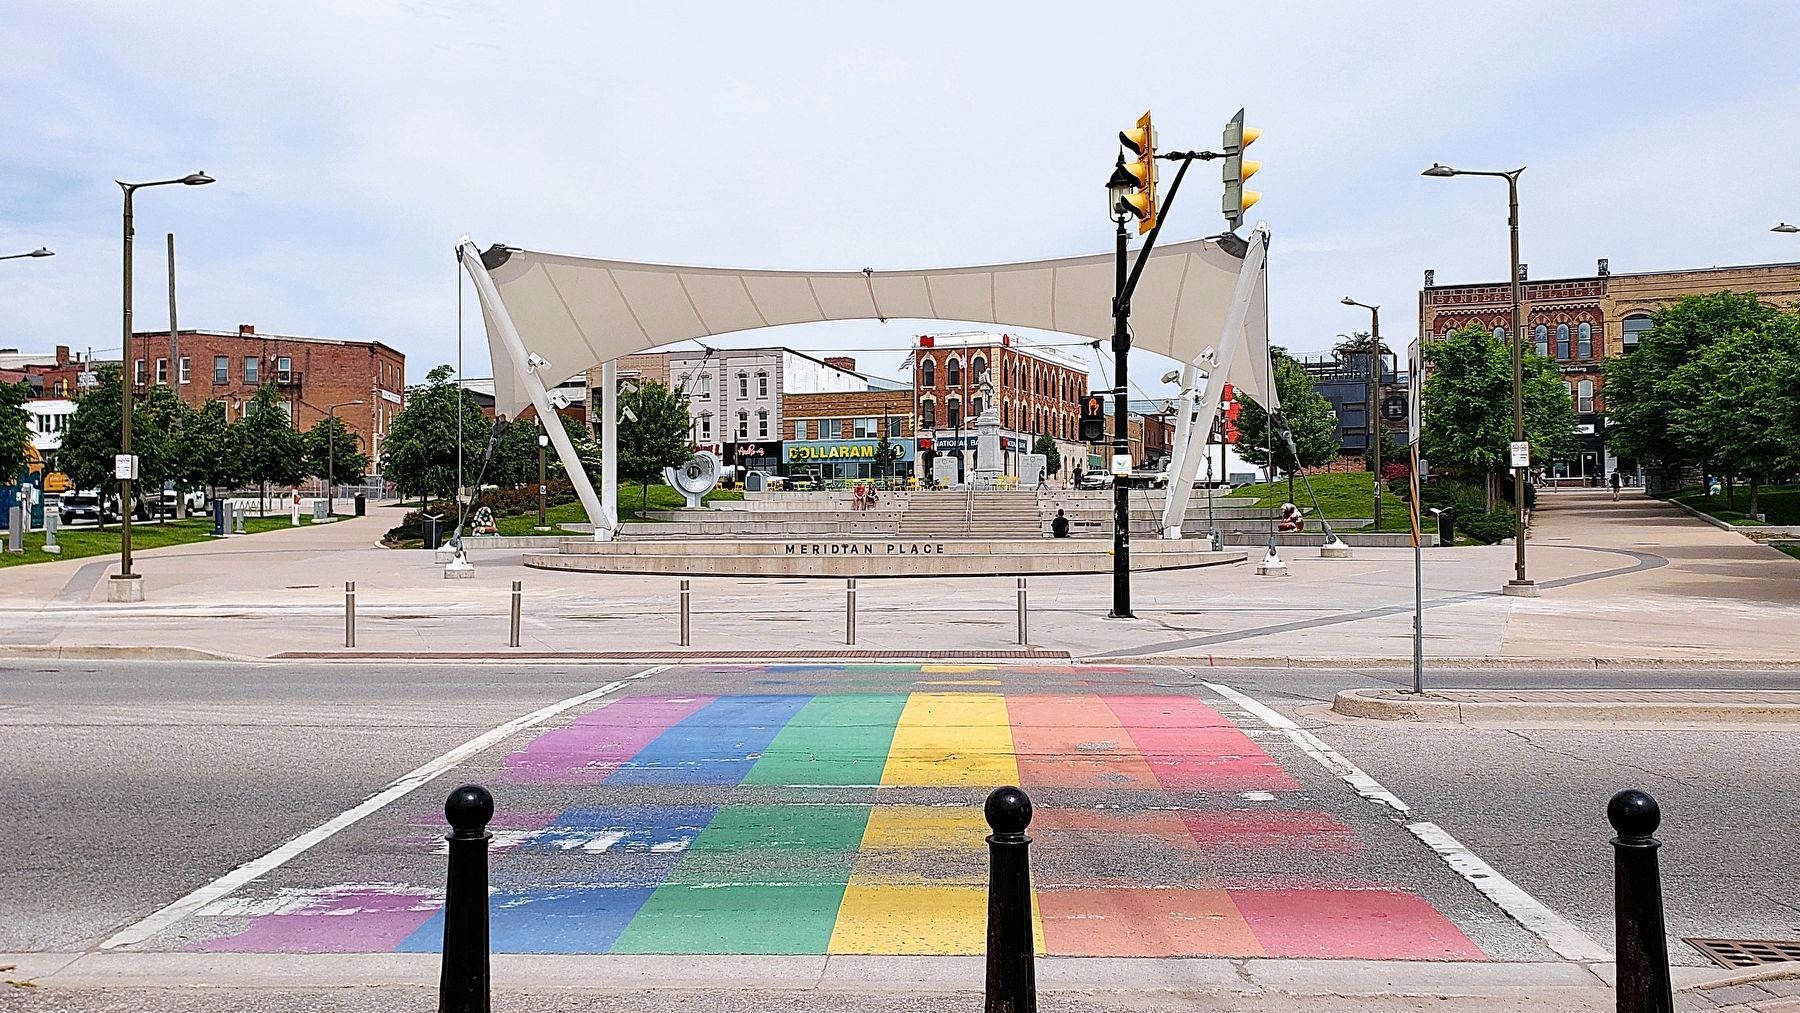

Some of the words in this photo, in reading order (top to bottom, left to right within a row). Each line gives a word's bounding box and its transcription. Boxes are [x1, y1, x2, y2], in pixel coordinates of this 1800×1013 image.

[1437, 293, 1512, 304] SANDERS
[1535, 288, 1597, 299] BLOCK
[788, 445, 877, 459] DOLLARAM
[785, 543, 873, 554] MERIDIAN
[887, 544, 944, 554] PLACE
